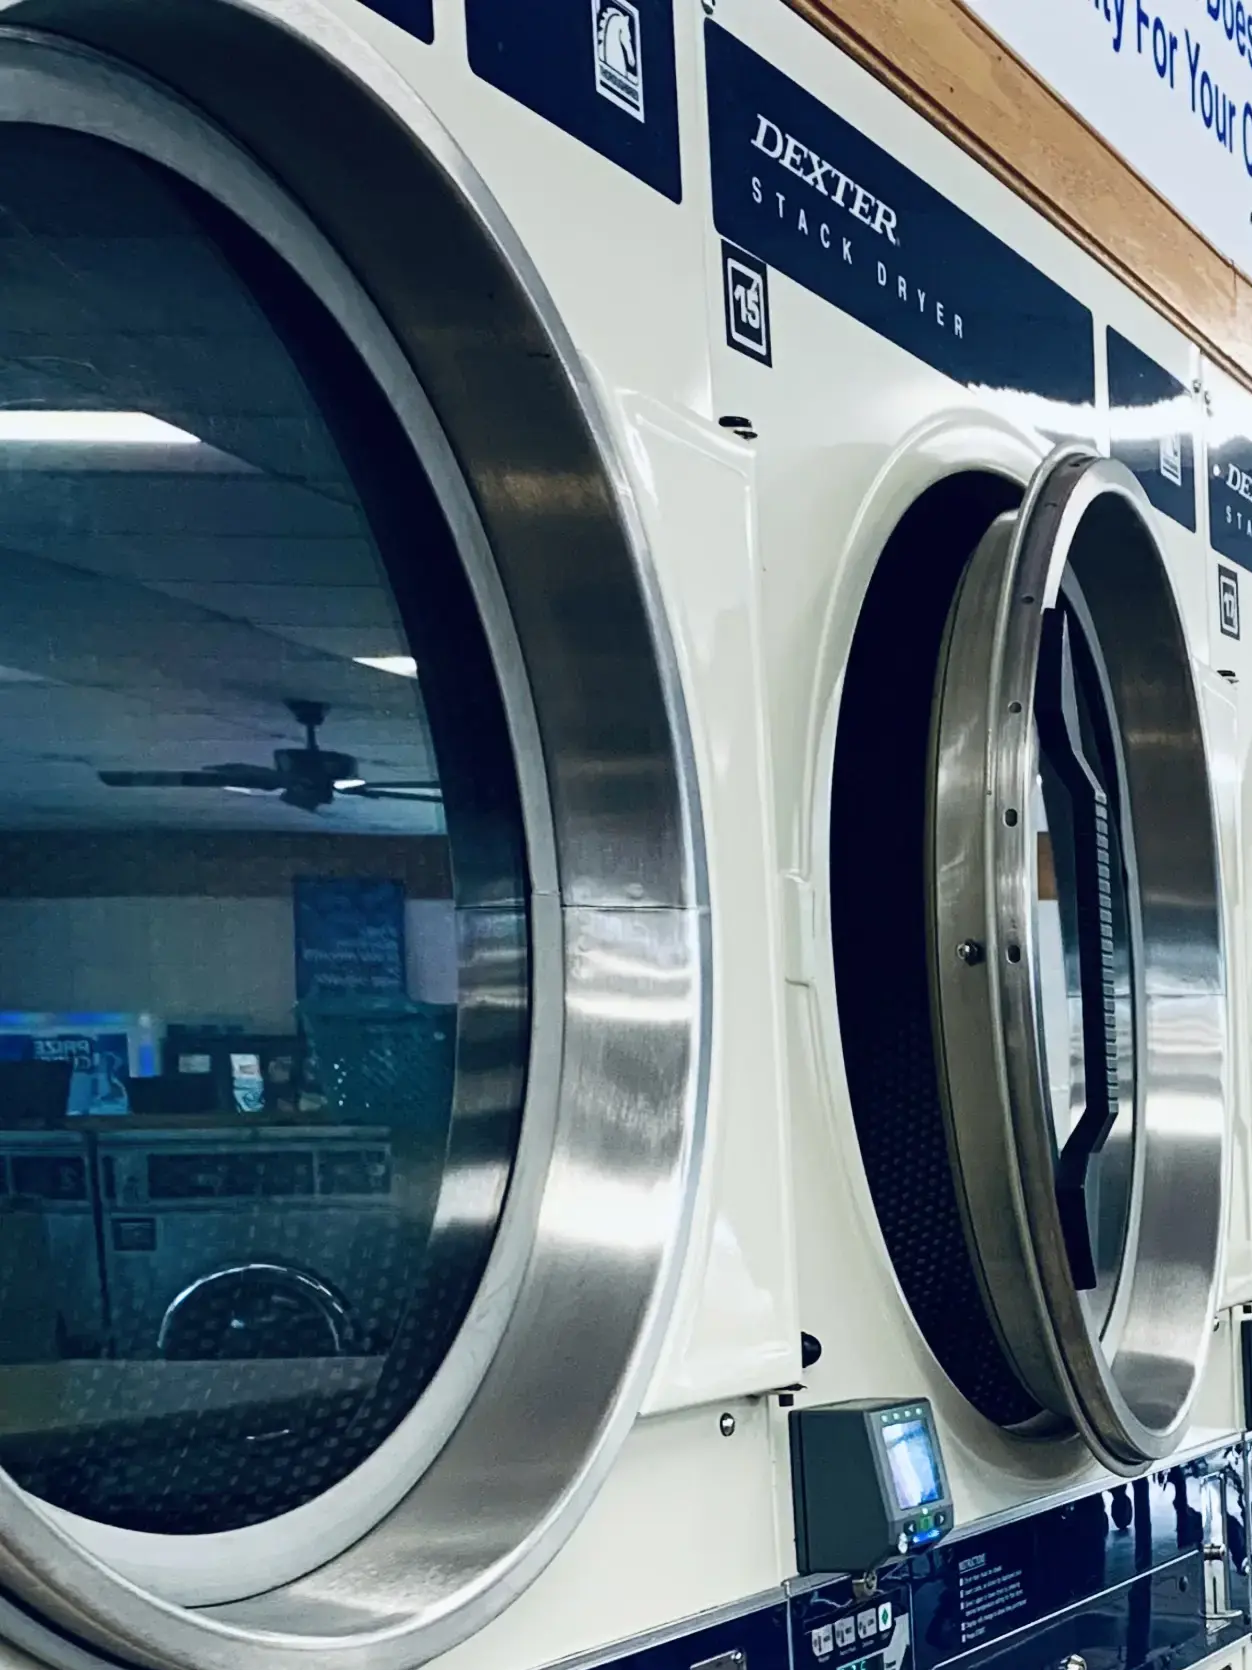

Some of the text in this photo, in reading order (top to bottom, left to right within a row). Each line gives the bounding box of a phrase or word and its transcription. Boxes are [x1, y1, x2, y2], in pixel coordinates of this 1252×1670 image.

[1184, 28, 1236, 154] Your
[750, 113, 899, 245] DEXTER
[734, 278, 761, 330] 15
[751, 176, 963, 339] STACK DRYER
